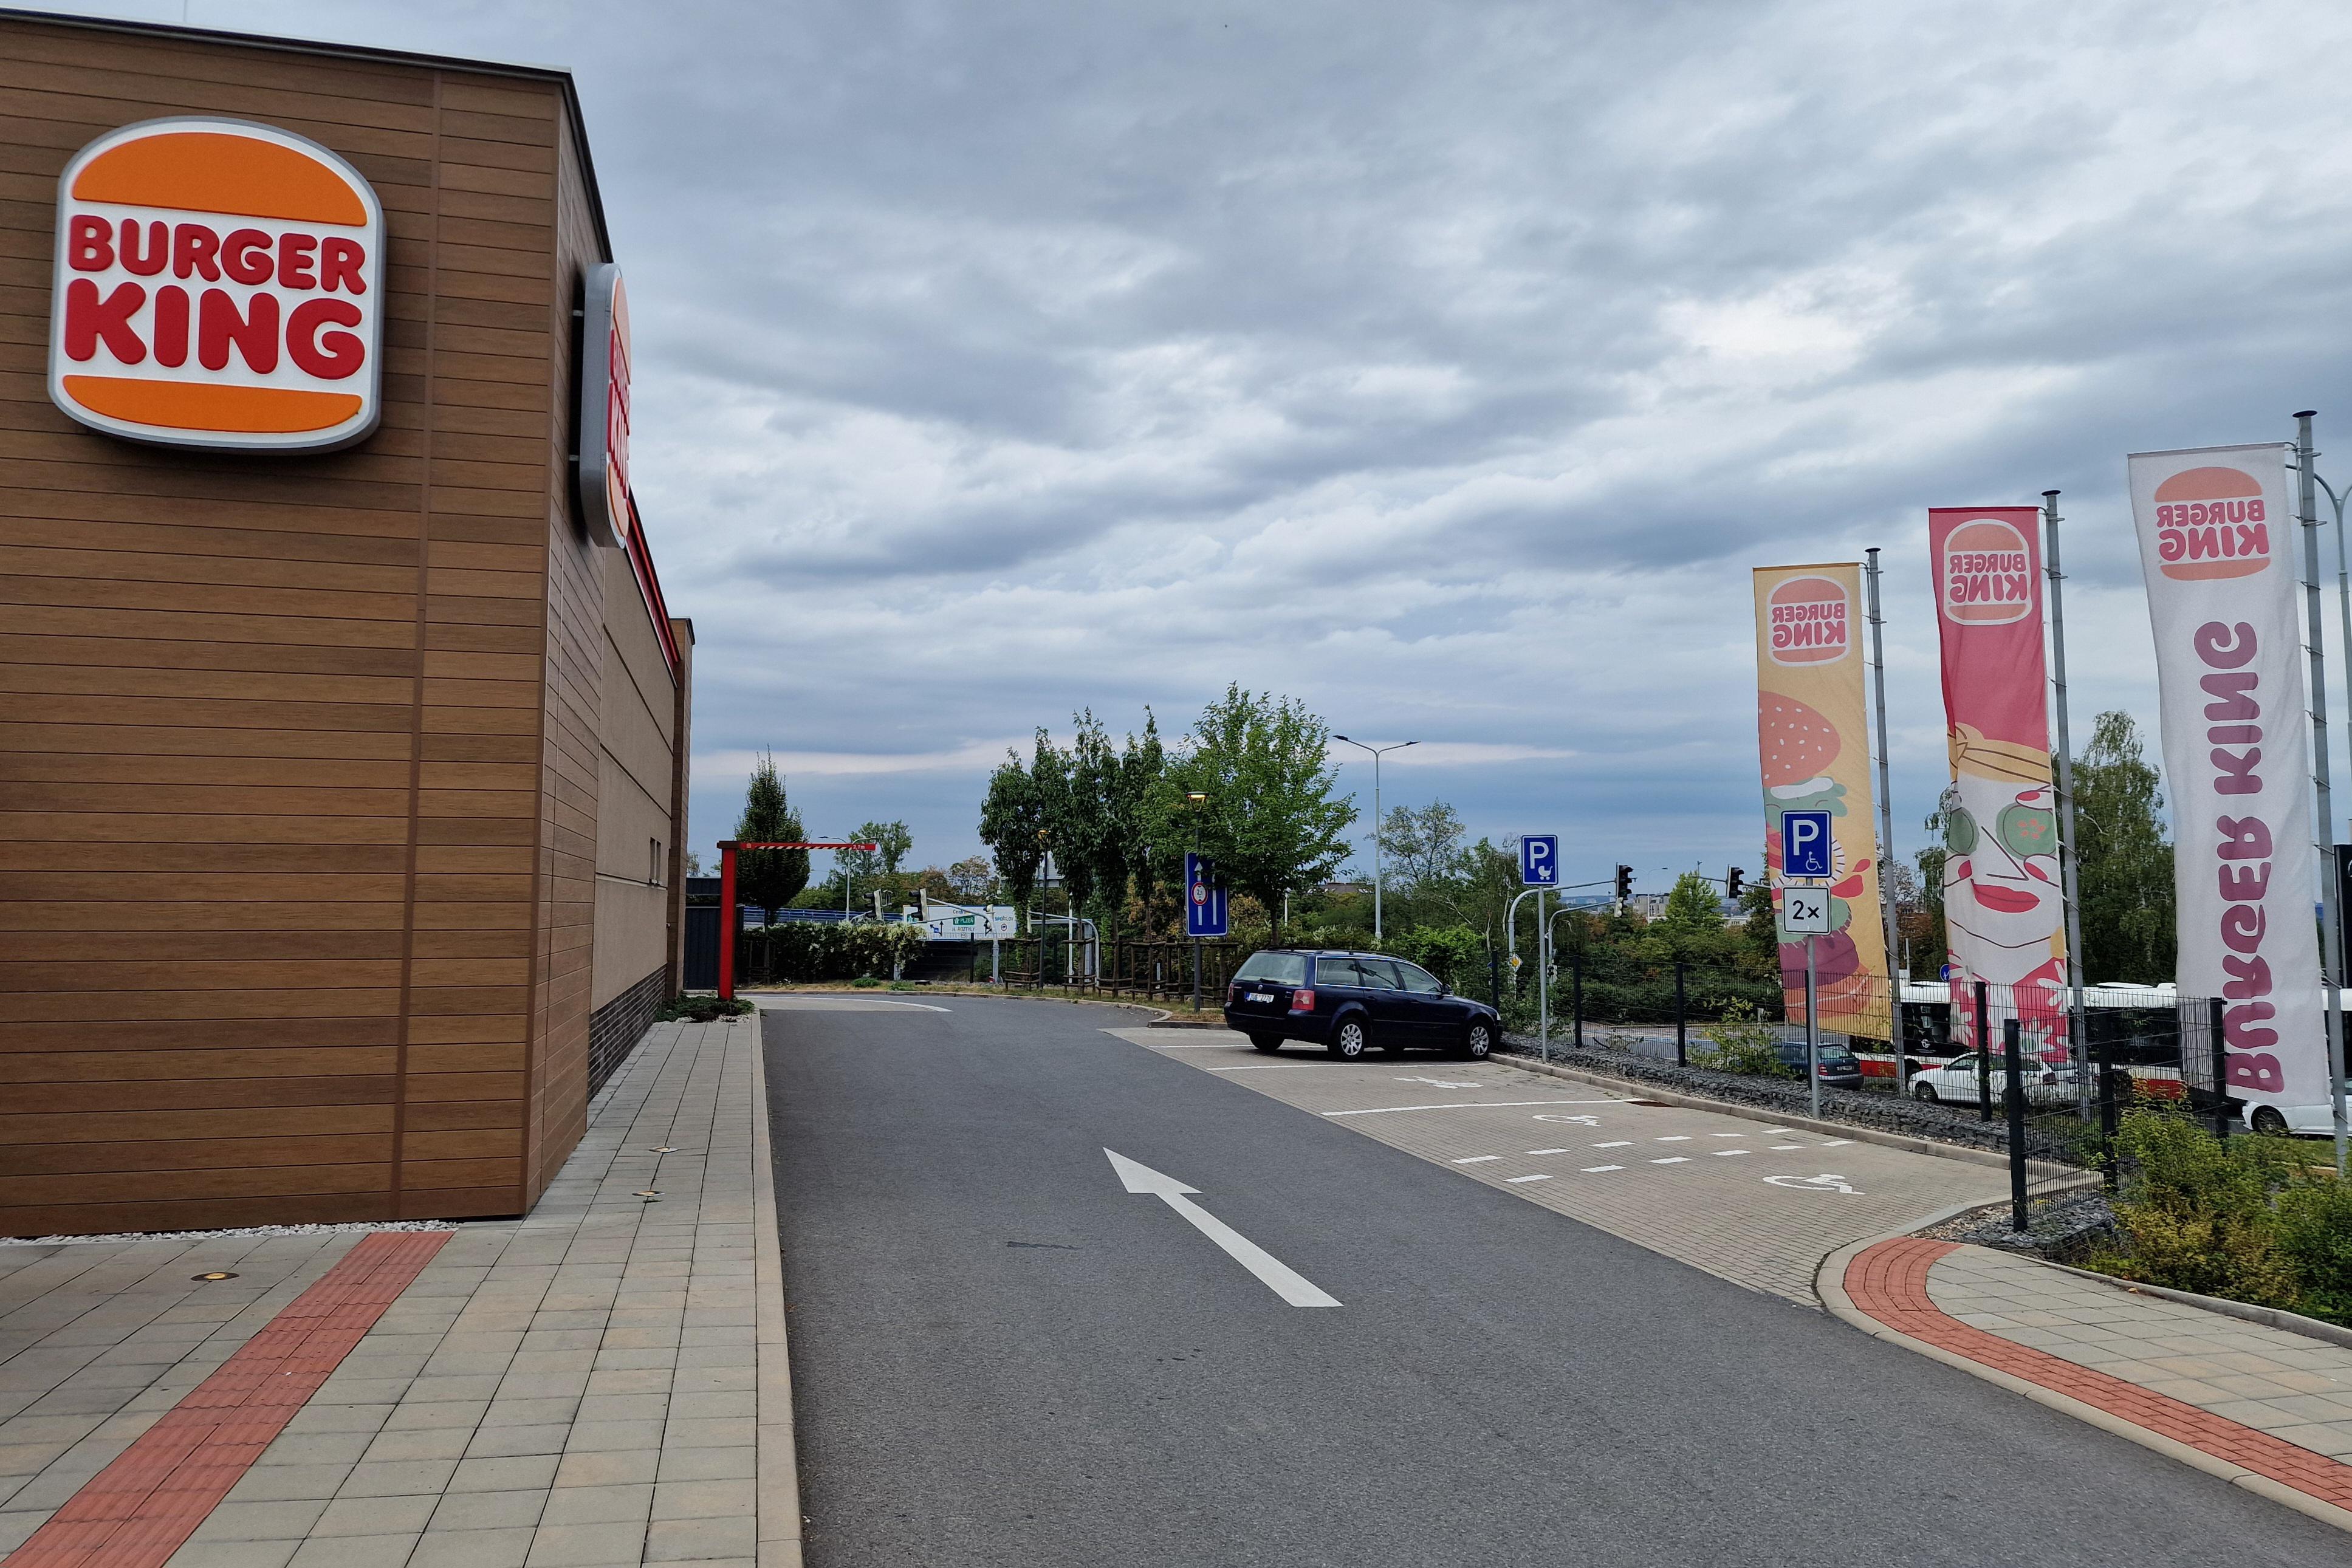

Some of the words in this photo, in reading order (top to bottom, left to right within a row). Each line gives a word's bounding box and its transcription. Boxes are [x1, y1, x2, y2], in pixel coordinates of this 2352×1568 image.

[68, 214, 367, 295] BURGER
[64, 278, 365, 380] KING
[1529, 841, 1549, 869] P
[1792, 820, 1819, 856] P
